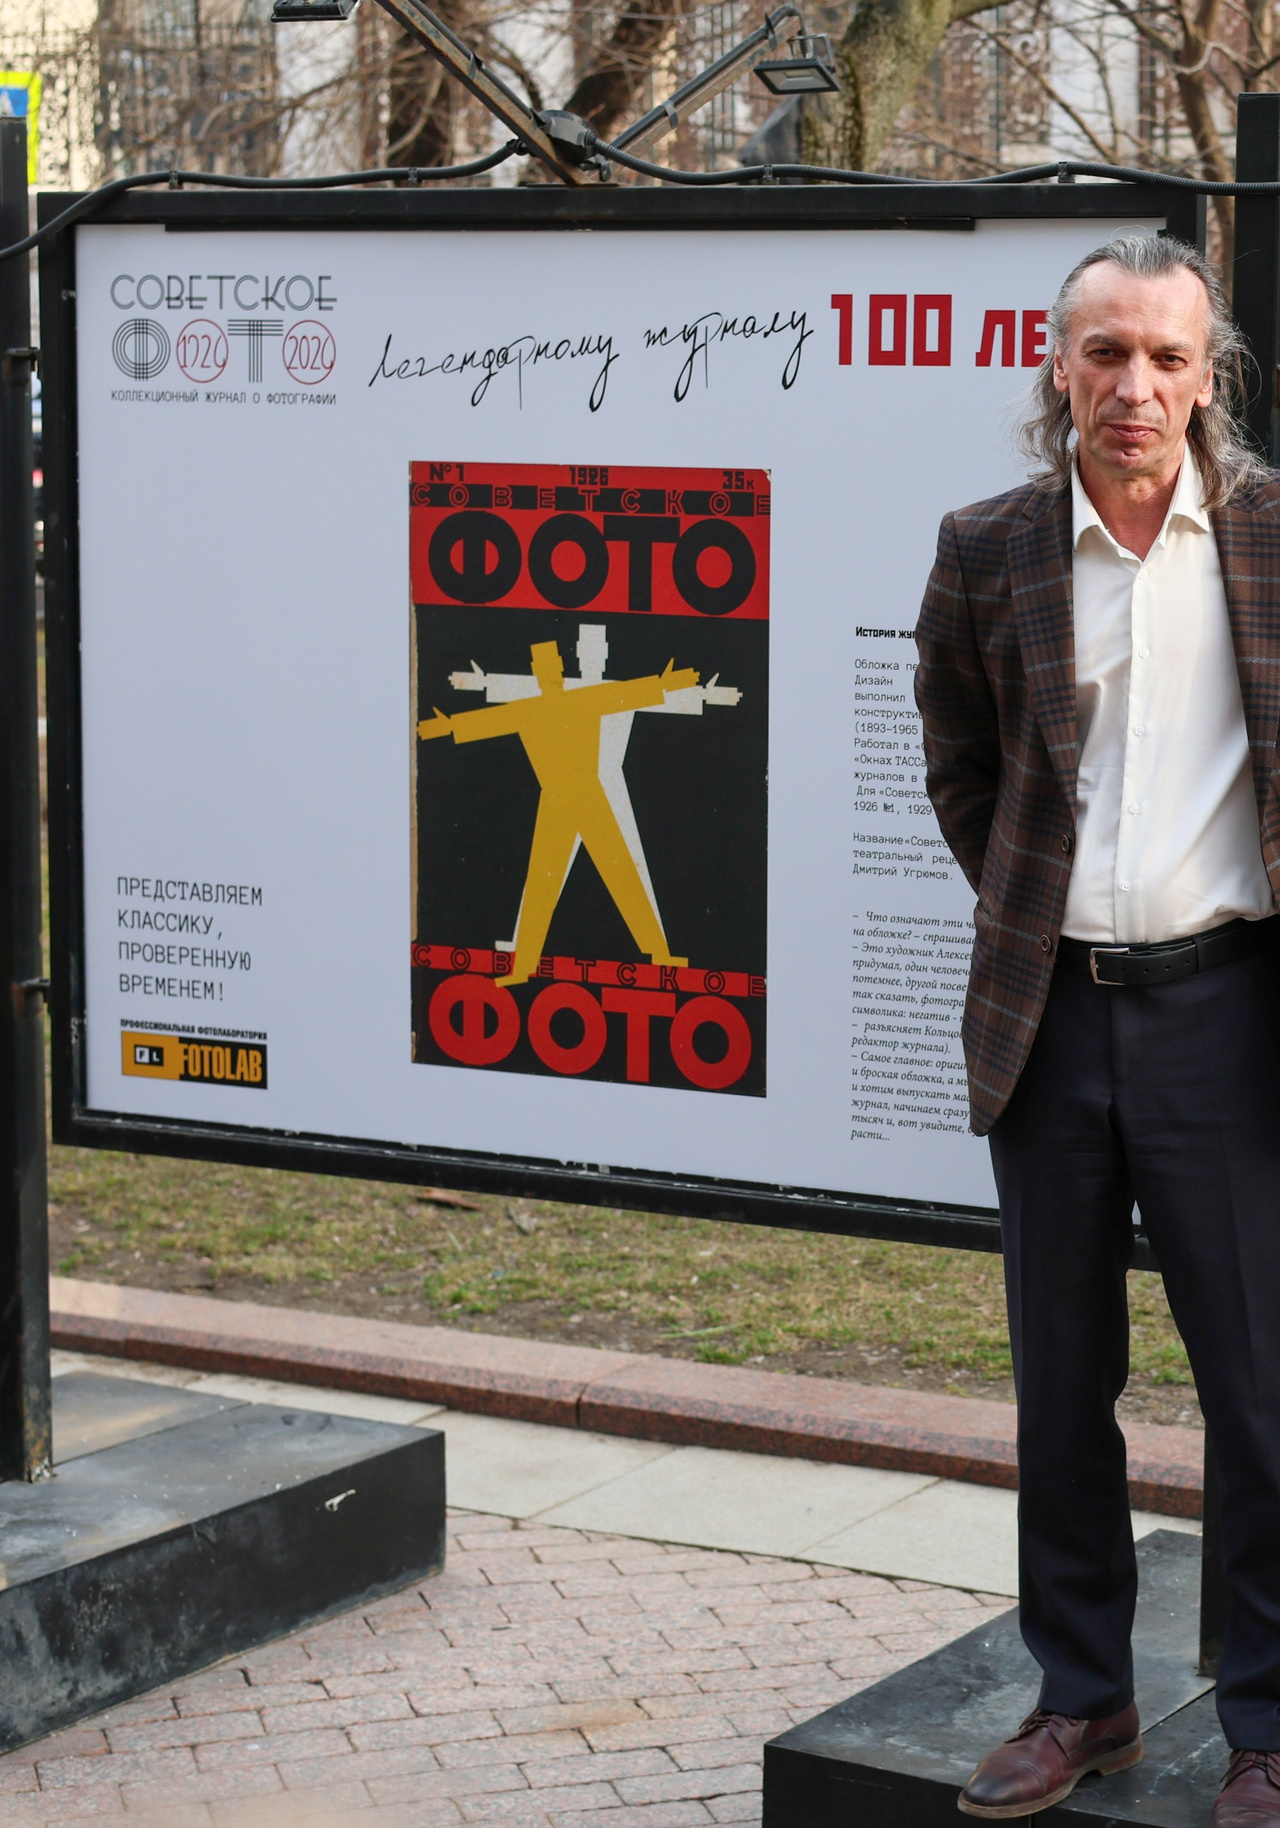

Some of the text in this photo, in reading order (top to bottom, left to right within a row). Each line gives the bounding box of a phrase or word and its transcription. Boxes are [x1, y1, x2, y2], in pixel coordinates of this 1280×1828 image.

[110, 274, 337, 311] СОВЕТСКОЕ
[369, 332, 620, 412] Легендарному
[643, 310, 814, 403] журналу
[831, 294, 952, 367] 100
[111, 389, 336, 405] КОЛЛЕКЦИОННЫЙ ЖУРНАЛ О ФОТОГРАФИИ
[569, 467, 609, 486] 1926
[410, 482, 771, 517] СОВЕТСКОЕ
[428, 511, 757, 616] ФОТО
[854, 658, 899, 671] Обложка
[854, 674, 893, 686] Дизайн
[855, 692, 906, 703] выполнил
[854, 737, 910, 751] Работал в
[854, 753, 892, 765] «Окнах
[854, 771, 905, 783] журналов
[856, 785, 876, 797] Для
[853, 801, 878, 812] 1926
[907, 804, 932, 815] 1929
[853, 832, 904, 845] Название
[853, 850, 923, 862] театральный
[853, 863, 953, 880] Дмитрий Угрюмов.
[117, 876, 262, 906] ПРЕДСТАВЛЯЕМ
[118, 909, 222, 940] КЛАССИКУ,
[866, 911, 963, 928] Что означают эти
[853, 927, 912, 940] на обложке?
[118, 941, 251, 971] ПРОВЕРЕННУЮ
[861, 942, 934, 958] Это художник
[412, 944, 767, 998] СОВЕТСКОЕ
[853, 957, 928, 973] придумал, один
[119, 973, 223, 1001] ВРЕМЕНЕМ!
[852, 975, 937, 991] потемнее, другой
[852, 991, 918, 1004] так сказать,
[852, 1006, 950, 1022] символика: негатив
[120, 1018, 267, 1040] ПРОФЕССИОНАЛЬНАЯ ФОТОЛАБОРАТОРИЯ
[428, 973, 752, 1090] ФОТО
[863, 1022, 922, 1035] разъясняет
[851, 1035, 950, 1055] редактор журнала).
[179, 1043, 263, 1083] FOTOLAB
[861, 1051, 933, 1067] Самое главное:
[850, 1129, 890, 1141] расти...
